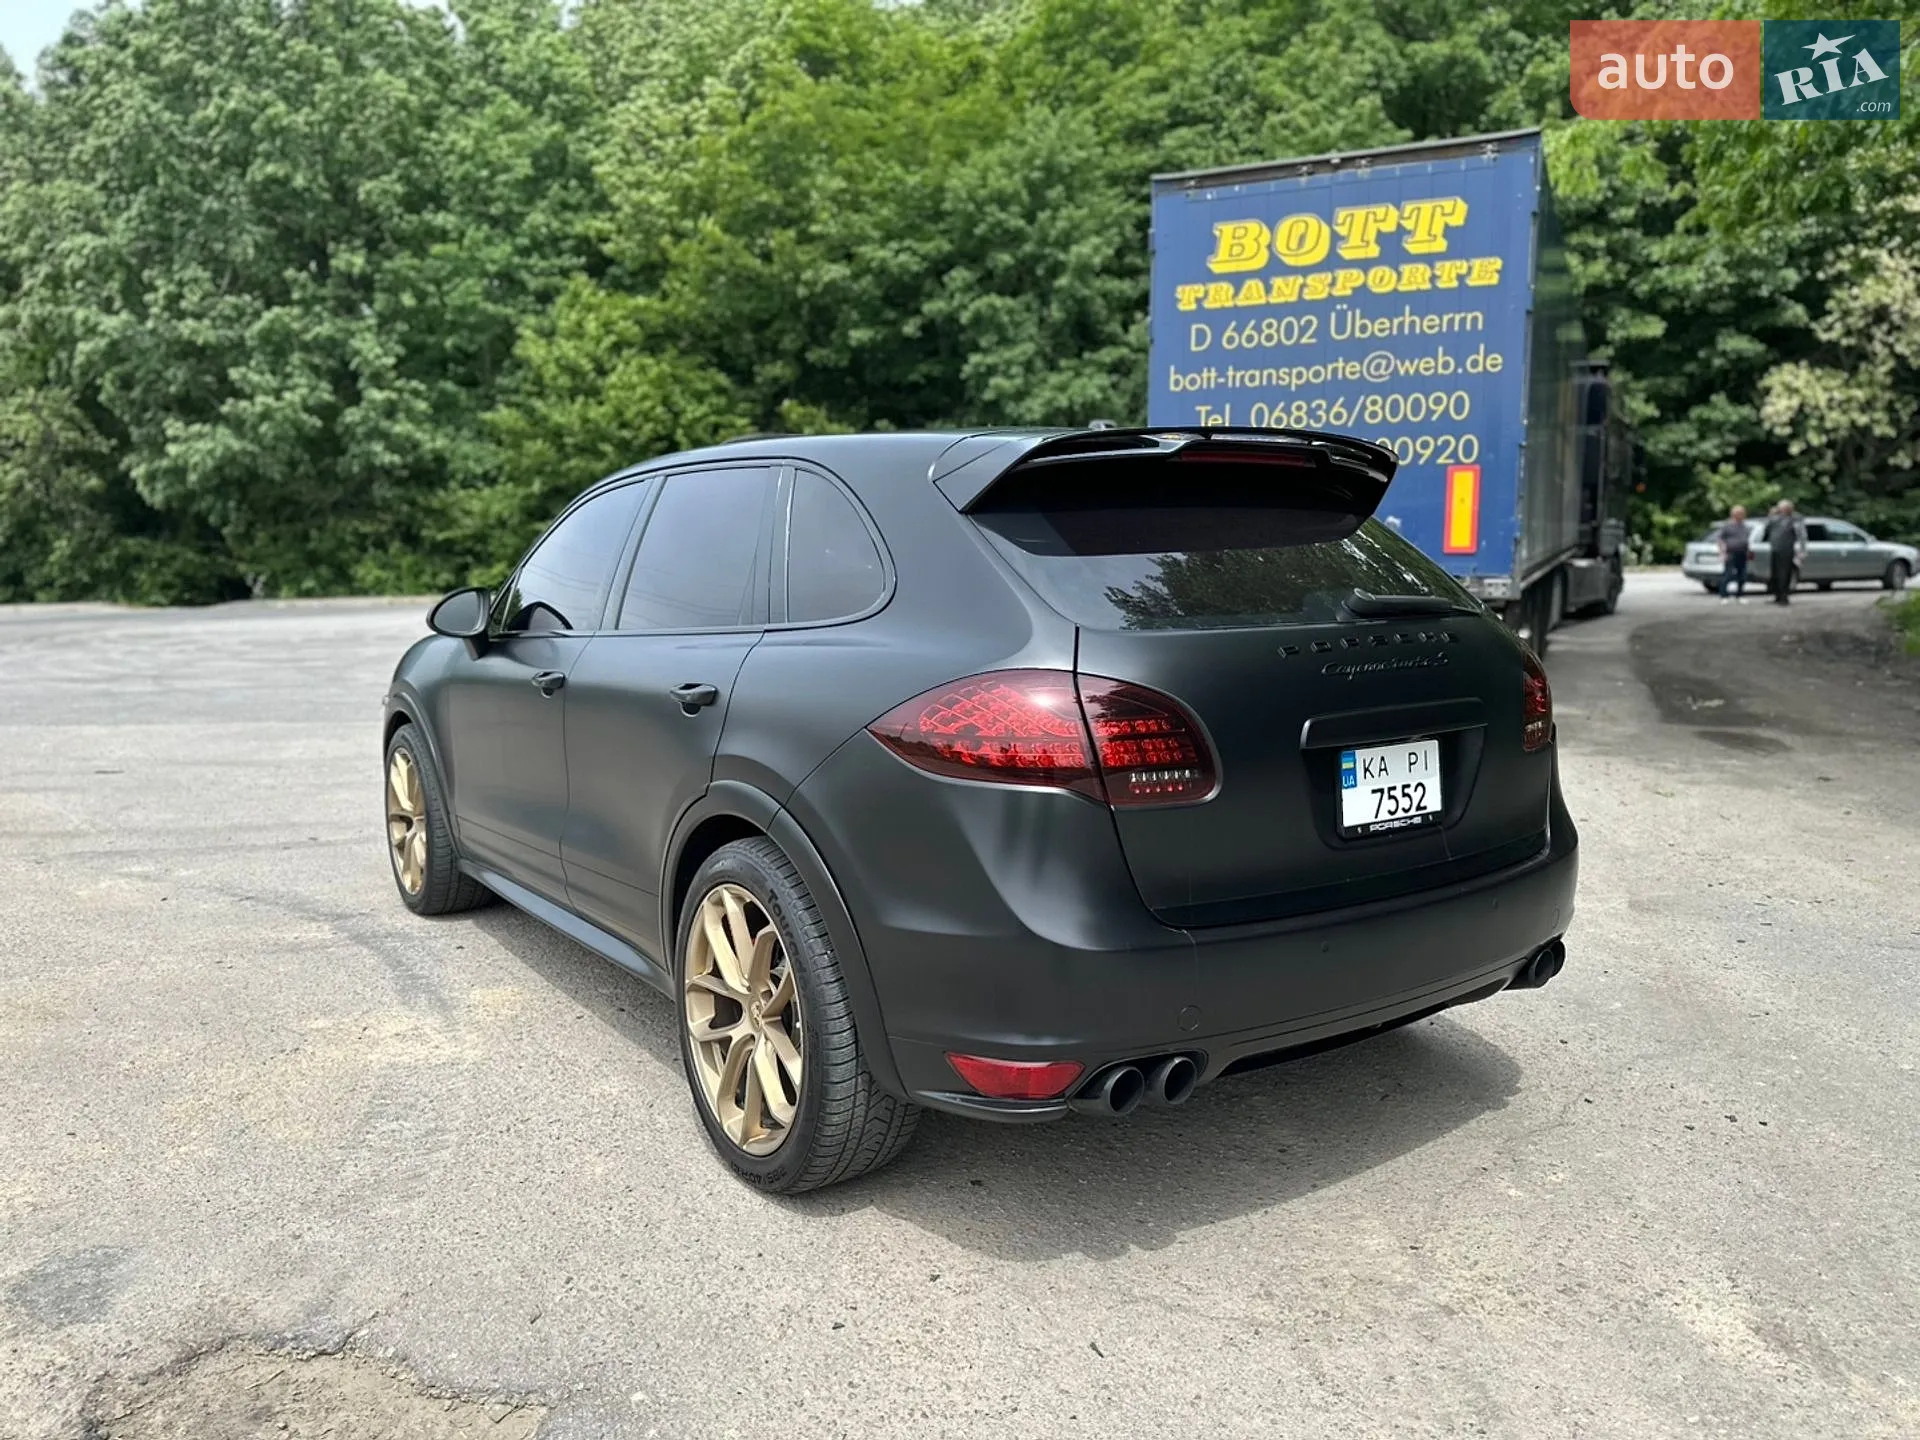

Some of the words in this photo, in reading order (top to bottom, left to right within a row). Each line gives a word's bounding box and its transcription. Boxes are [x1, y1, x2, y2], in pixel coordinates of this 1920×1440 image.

[1207, 197, 1467, 273] BOTT
[1175, 256, 1503, 311] TRANSPORTE
[1190, 324, 1212, 352] D
[1221, 317, 1318, 350] 66802
[1329, 305, 1484, 341] Überherrn
[1169, 343, 1503, 392] bott-transporte@web.de
[1250, 391, 1470, 428] 06836/80090
[1342, 775, 1356, 788] UA
[1362, 755, 1389, 780] KA
[1408, 749, 1429, 774] PI
[1371, 782, 1428, 819] 7552
[1369, 816, 1422, 832] PORSCHE
